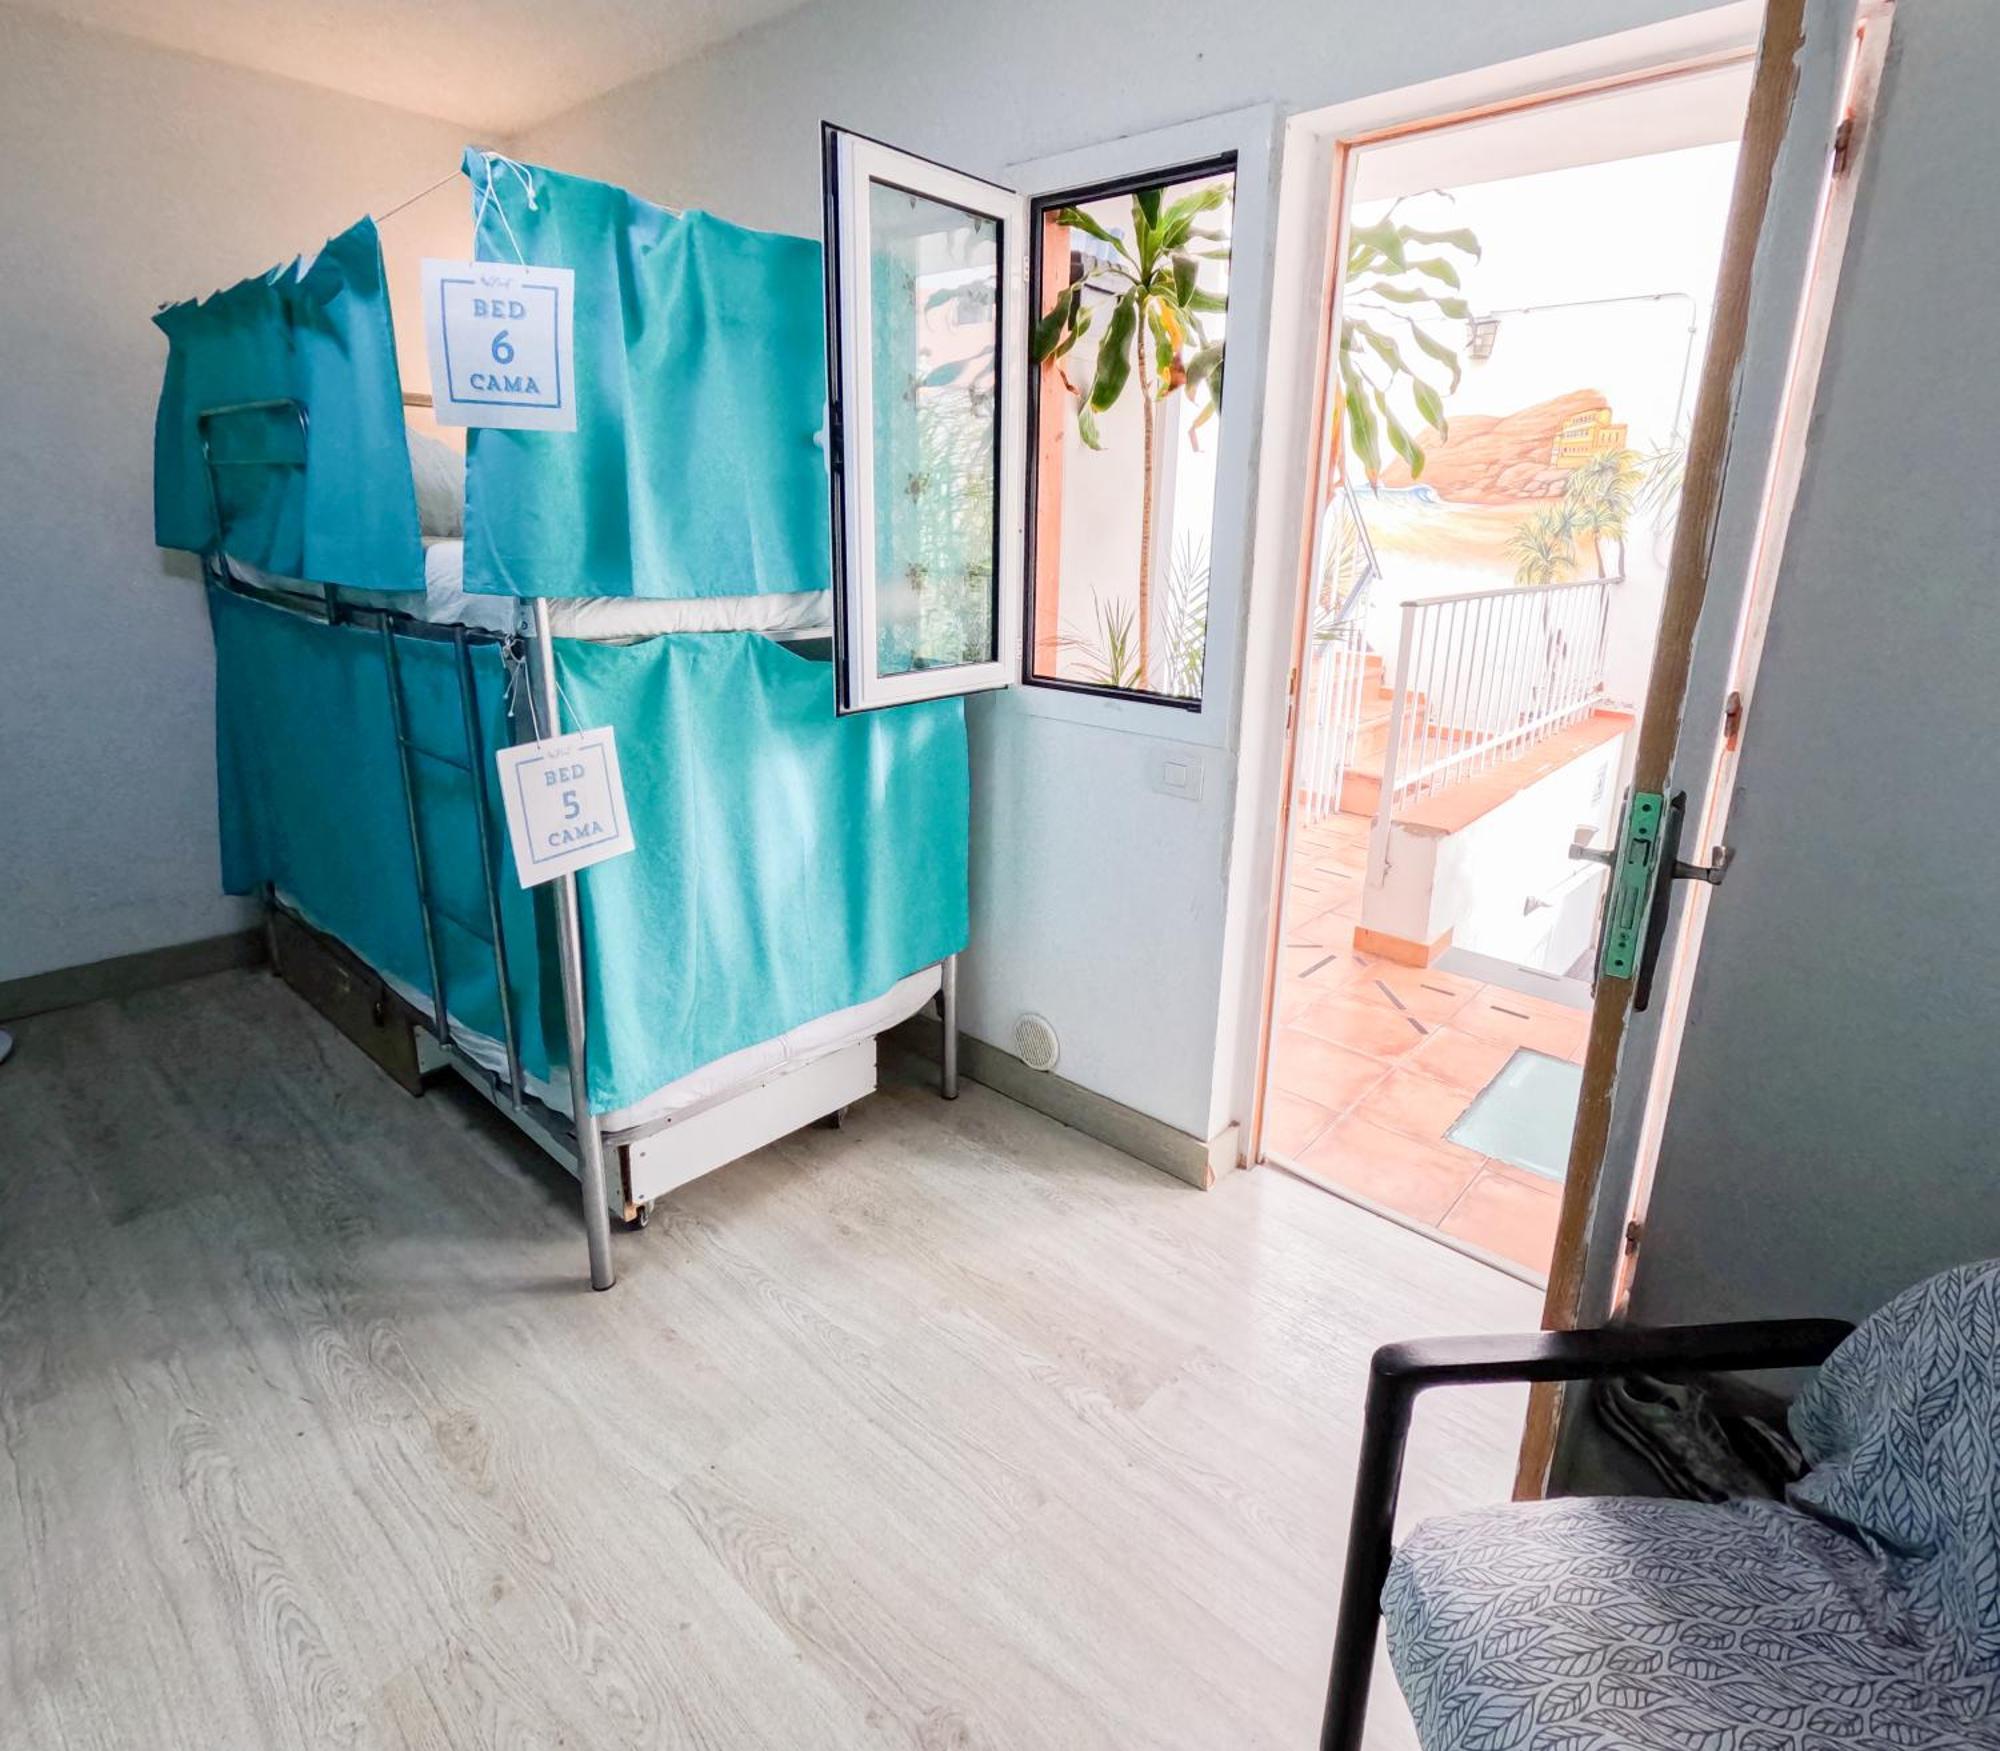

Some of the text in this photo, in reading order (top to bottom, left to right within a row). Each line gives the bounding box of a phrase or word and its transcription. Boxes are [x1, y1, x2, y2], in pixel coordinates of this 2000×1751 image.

[474, 299, 526, 318] BED
[491, 330, 514, 365] 6
[470, 373, 540, 394] CAMA
[544, 764, 585, 786] BED
[562, 790, 580, 819] 5
[548, 821, 603, 847] CAMA
